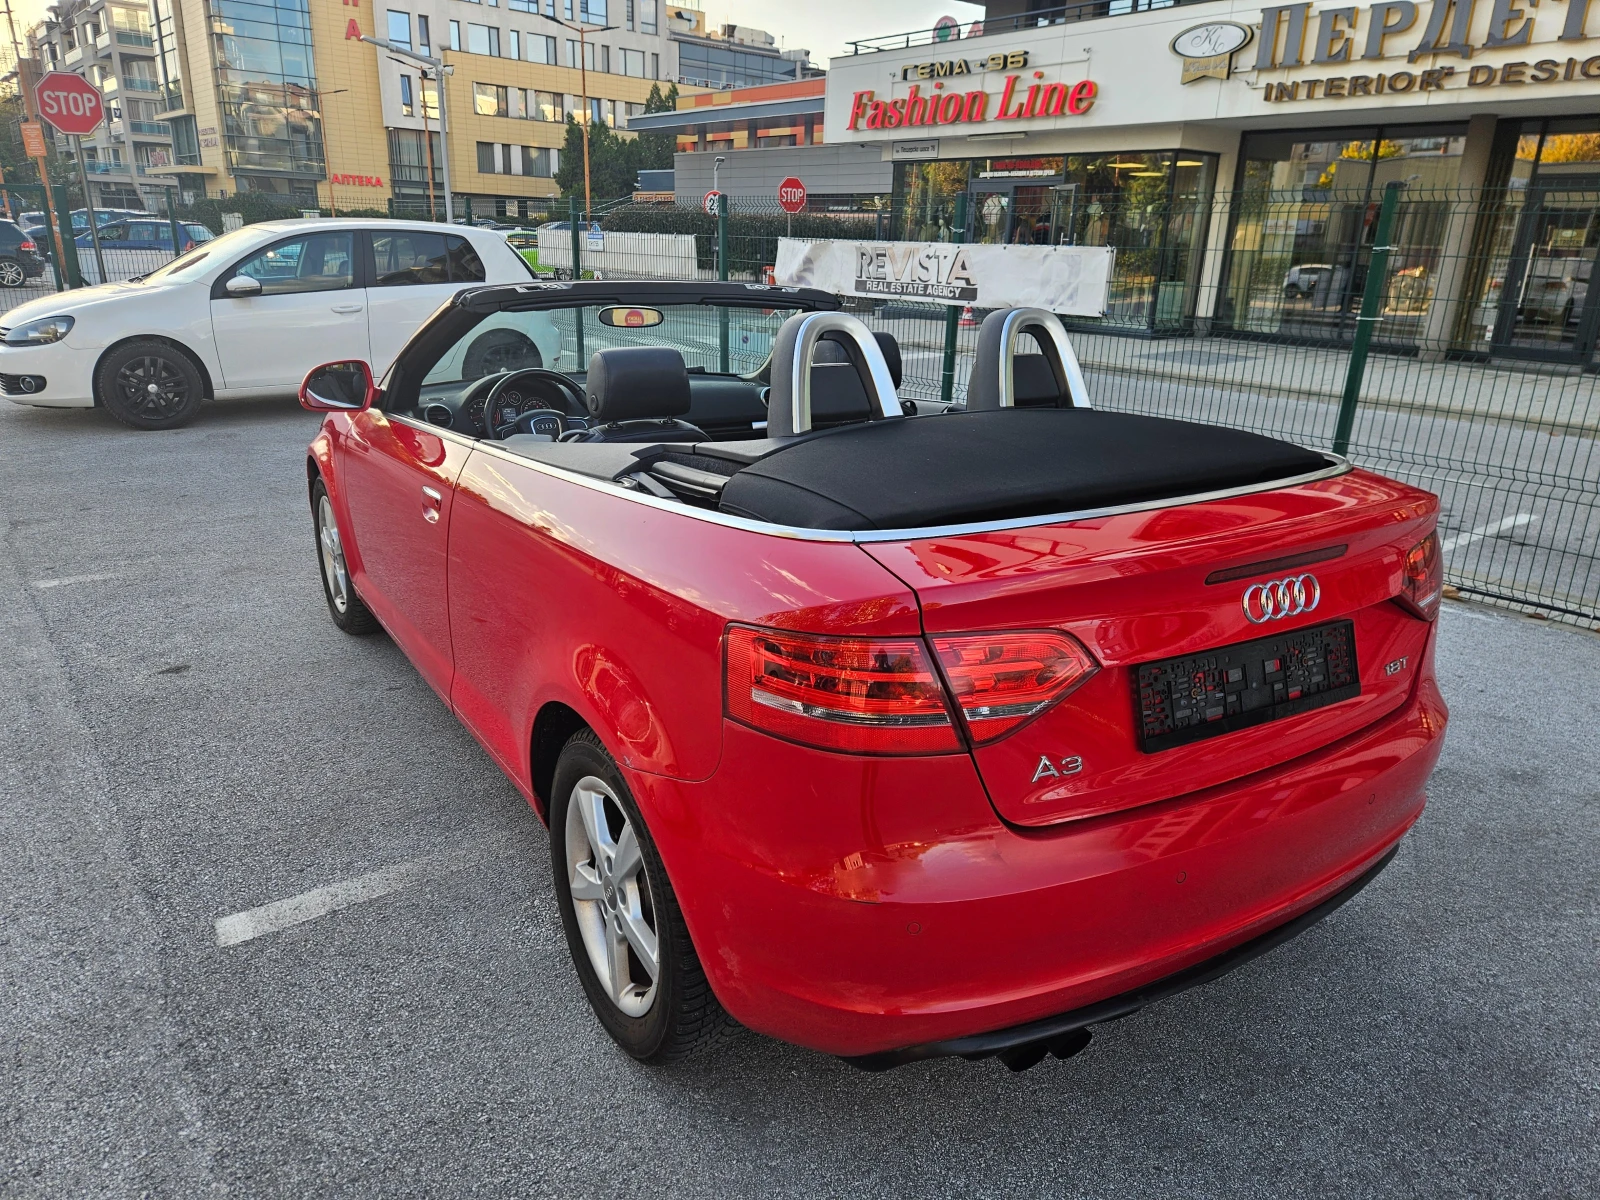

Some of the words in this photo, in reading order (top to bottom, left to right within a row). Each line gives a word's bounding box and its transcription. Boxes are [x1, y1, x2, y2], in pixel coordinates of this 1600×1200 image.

[1264, 69, 1444, 101] INTERIOR
[43, 90, 96, 116] STOP
[846, 82, 989, 131] Fashion
[995, 71, 1097, 120] Line
[331, 173, 384, 187] АПТЕКА
[781, 188, 804, 202] STOP
[855, 246, 978, 287] REVISTA
[866, 281, 889, 292] REAL
[890, 282, 925, 294] ESTATE
[926, 284, 962, 298] AGENCY
[1031, 755, 1083, 783] A3
